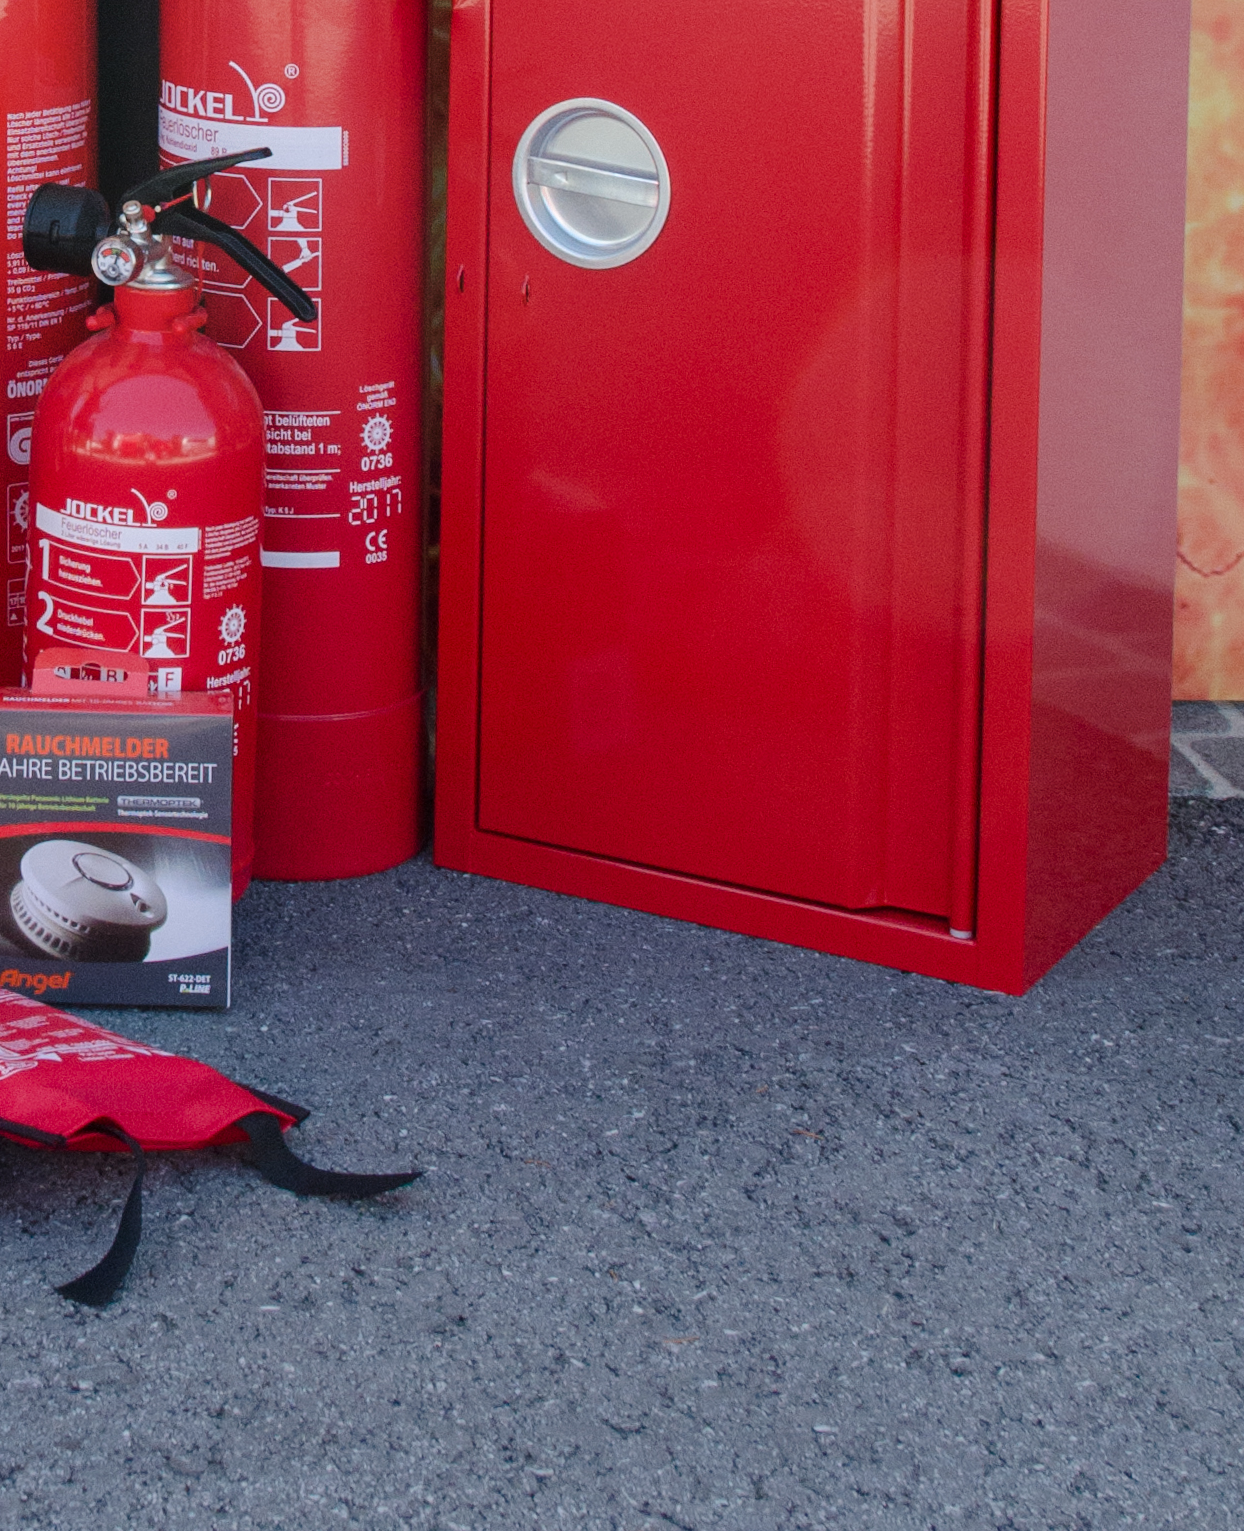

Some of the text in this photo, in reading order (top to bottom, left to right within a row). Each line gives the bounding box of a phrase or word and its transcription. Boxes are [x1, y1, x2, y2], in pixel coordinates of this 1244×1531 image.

[160, 79, 244, 121] JOCKEL
[7, 378, 49, 399] ÖNOR
[275, 414, 331, 427] belüfteten
[294, 428, 312, 441] bei
[318, 443, 324, 454] 1
[361, 452, 393, 471] 0736
[60, 498, 141, 526] JOCKEL
[348, 488, 402, 525] 2017
[60, 517, 123, 540] Feuerlöscher
[39, 538, 50, 581] 1
[365, 552, 388, 565] 0035
[36, 590, 55, 636] 2
[218, 643, 246, 666] 0736
[165, 671, 175, 688] F
[5, 733, 169, 759] RAUCHMELDER
[58, 758, 218, 784] BETRIEBSBEREIT
[119, 797, 198, 808] THERMOPTEK
[167, 973, 211, 983] ST-622-DET
